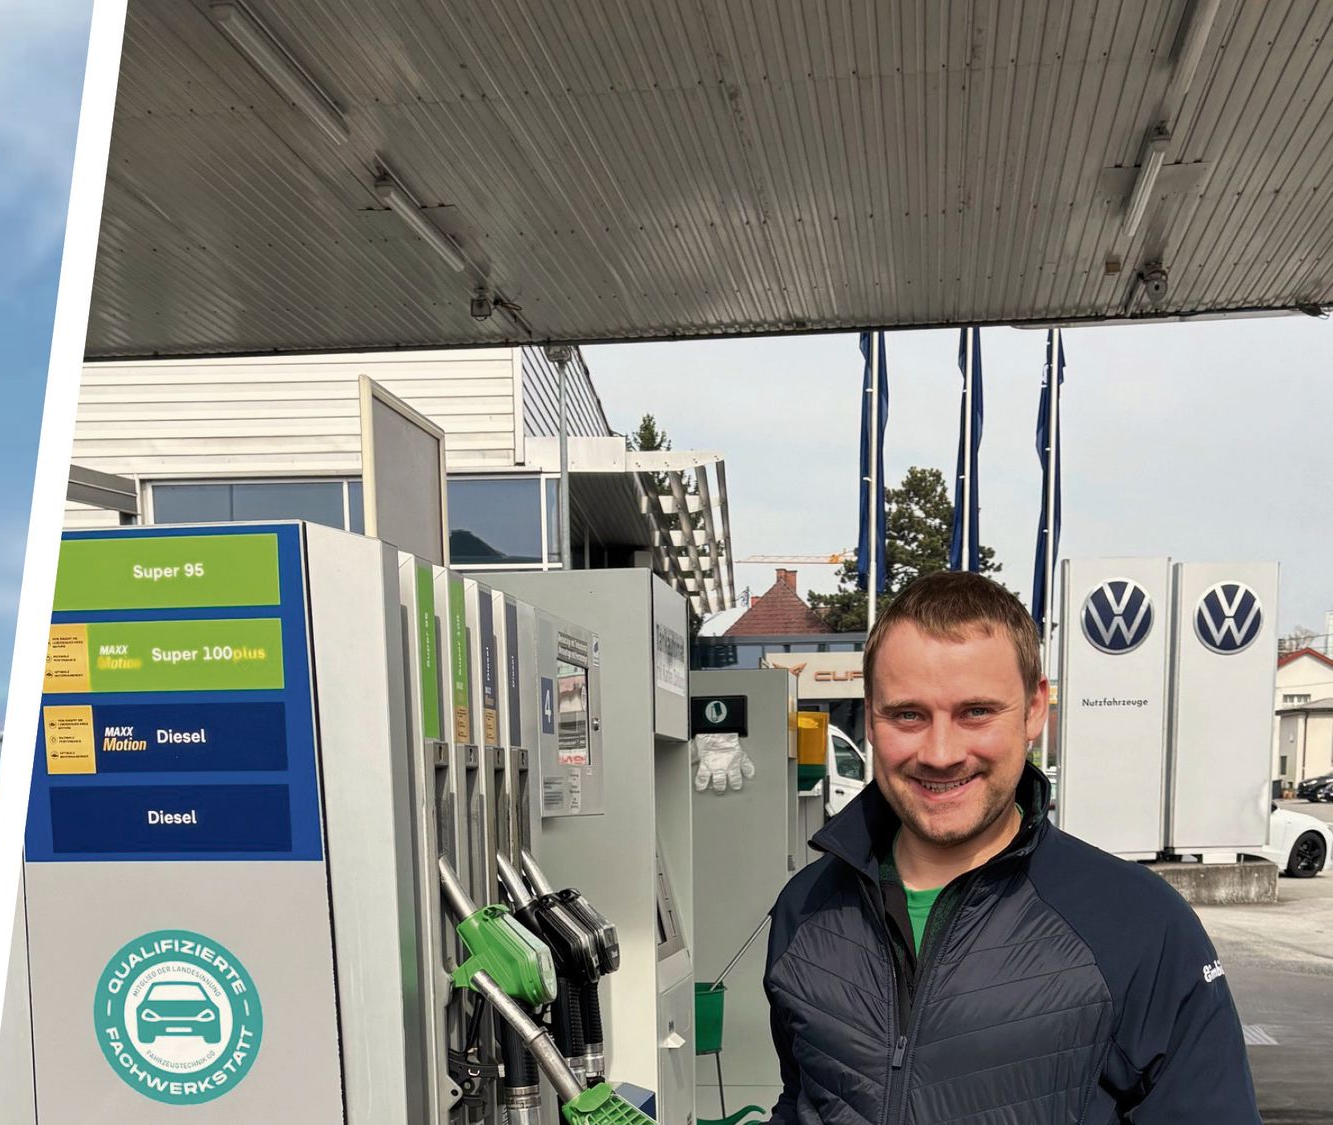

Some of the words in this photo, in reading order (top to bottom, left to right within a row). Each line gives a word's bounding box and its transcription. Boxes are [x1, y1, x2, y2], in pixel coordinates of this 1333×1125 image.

[133, 564, 180, 581] Super
[184, 563, 205, 577] 95
[99, 645, 129, 656] MAXX
[151, 647, 199, 664] Super
[202, 646, 267, 663] 100plus
[96, 656, 143, 671] Motion
[814, 670, 864, 682] CUP
[544, 688, 552, 723] 4
[1081, 697, 1149, 708] Nutzfahrzeuge
[104, 727, 134, 738] MAXX
[156, 729, 207, 744] Diesel
[102, 737, 147, 752] Motion
[147, 810, 197, 824] Diesel
[107, 939, 248, 996] QUALIFIZIERTE
[132, 971, 157, 997] MITGLIED
[157, 966, 171, 976] DER
[172, 965, 222, 998] LANDESINNUNG
[105, 1025, 254, 1095] FACHWERKSTATT
[146, 1049, 207, 1069] FAHRZEUGTECHNIK
